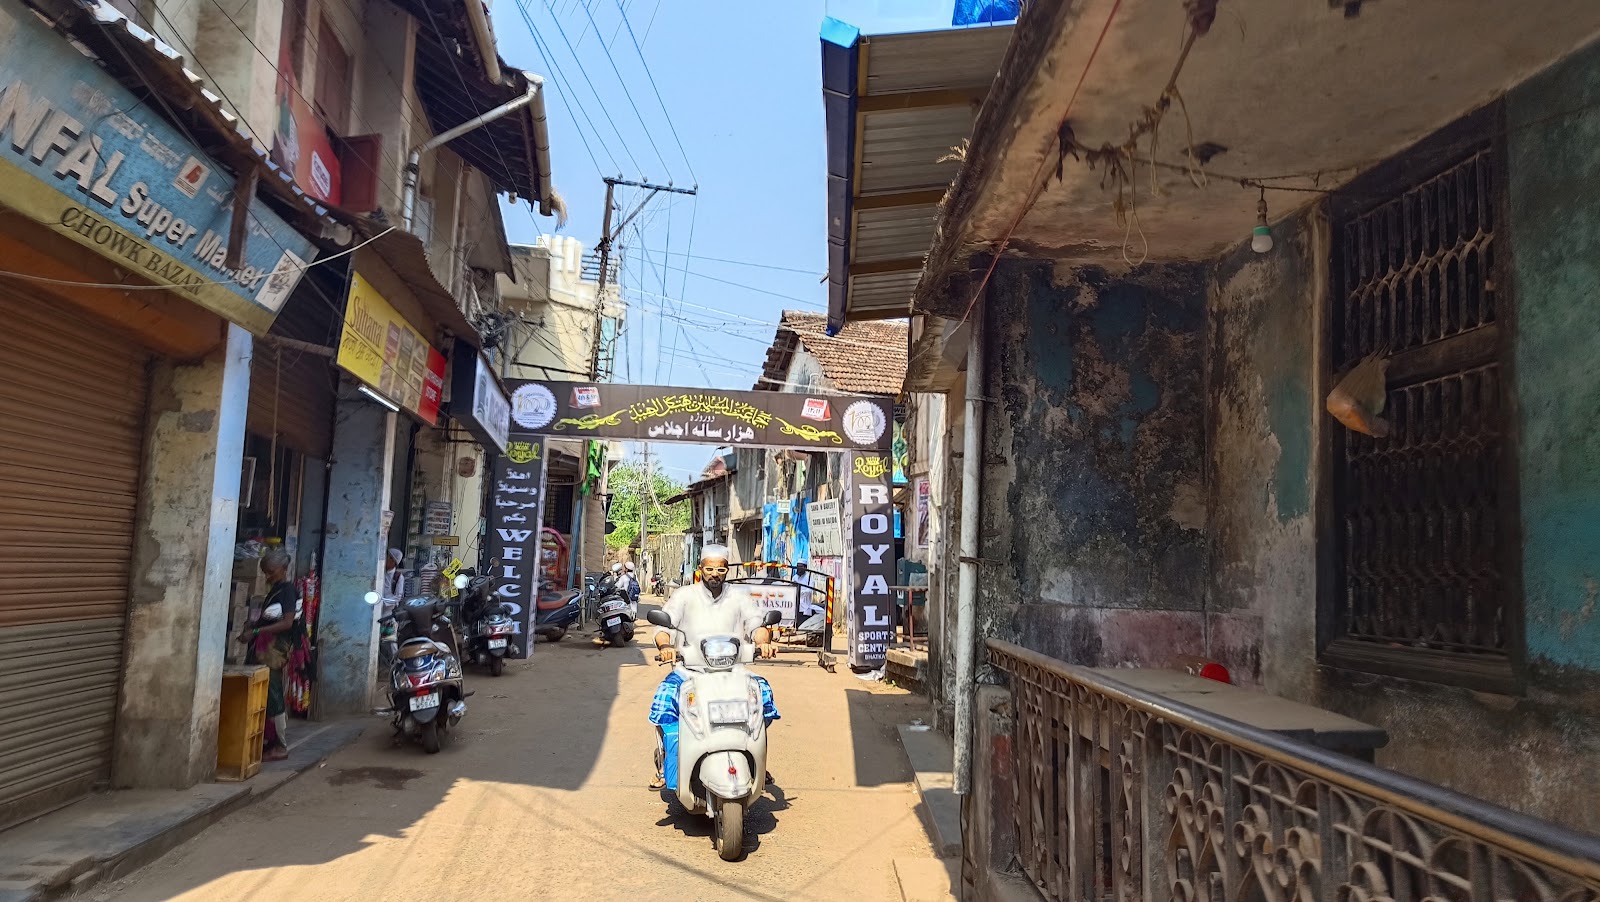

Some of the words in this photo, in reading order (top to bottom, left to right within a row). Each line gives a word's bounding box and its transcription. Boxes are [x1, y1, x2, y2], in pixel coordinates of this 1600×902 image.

[121, 181, 197, 249] Super
[60, 206, 147, 264] CHOWK
[144, 251, 205, 296] BAZAR
[853, 456, 891, 478] Royal
[858, 483, 892, 626] ROYAL
[762, 599, 793, 609] MASJID
[858, 630, 895, 641] SPORTS
